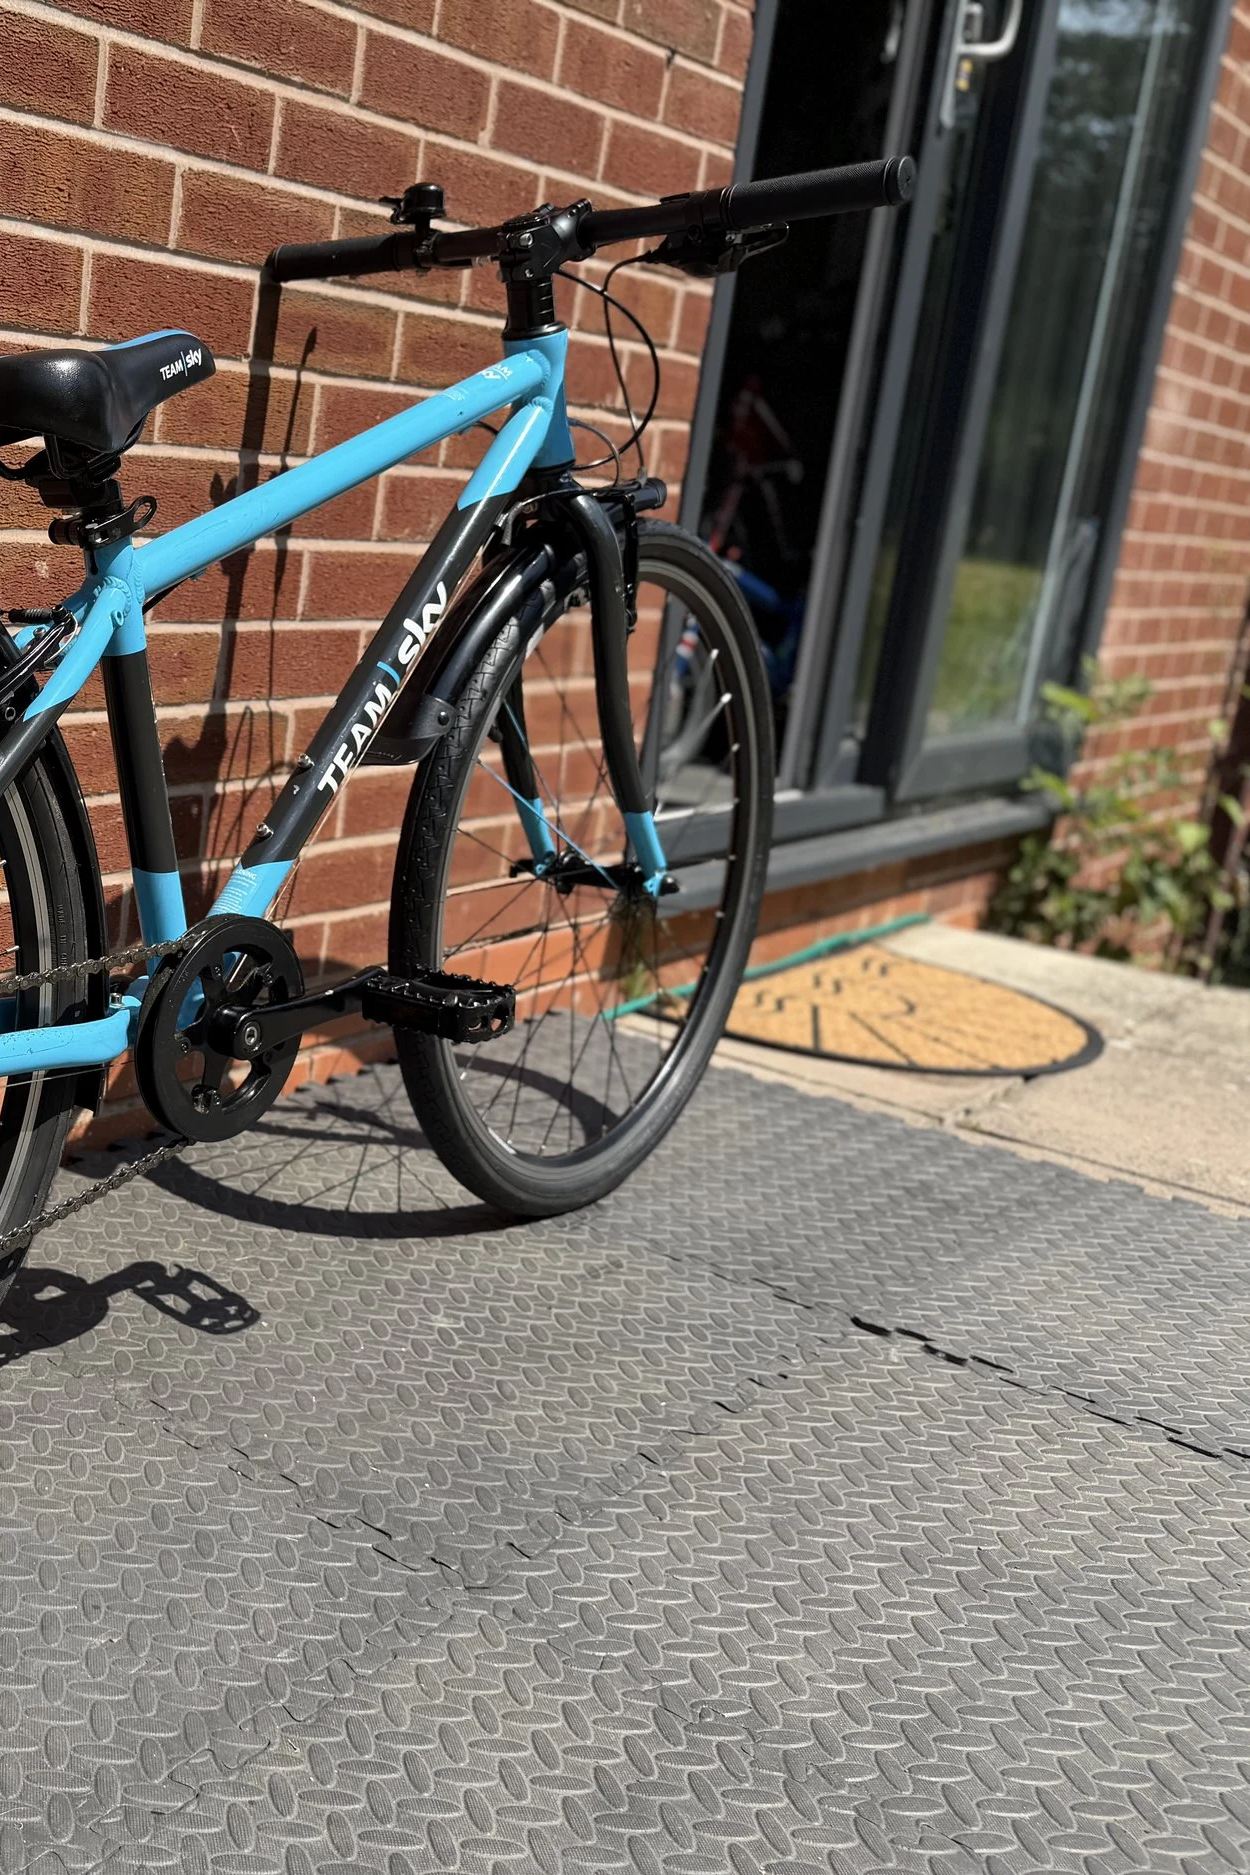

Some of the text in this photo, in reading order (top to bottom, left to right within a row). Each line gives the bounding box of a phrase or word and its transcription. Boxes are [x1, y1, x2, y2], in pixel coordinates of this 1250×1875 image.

[159, 348, 202, 380] TEAM sky
[317, 581, 448, 793] TEAM sky
